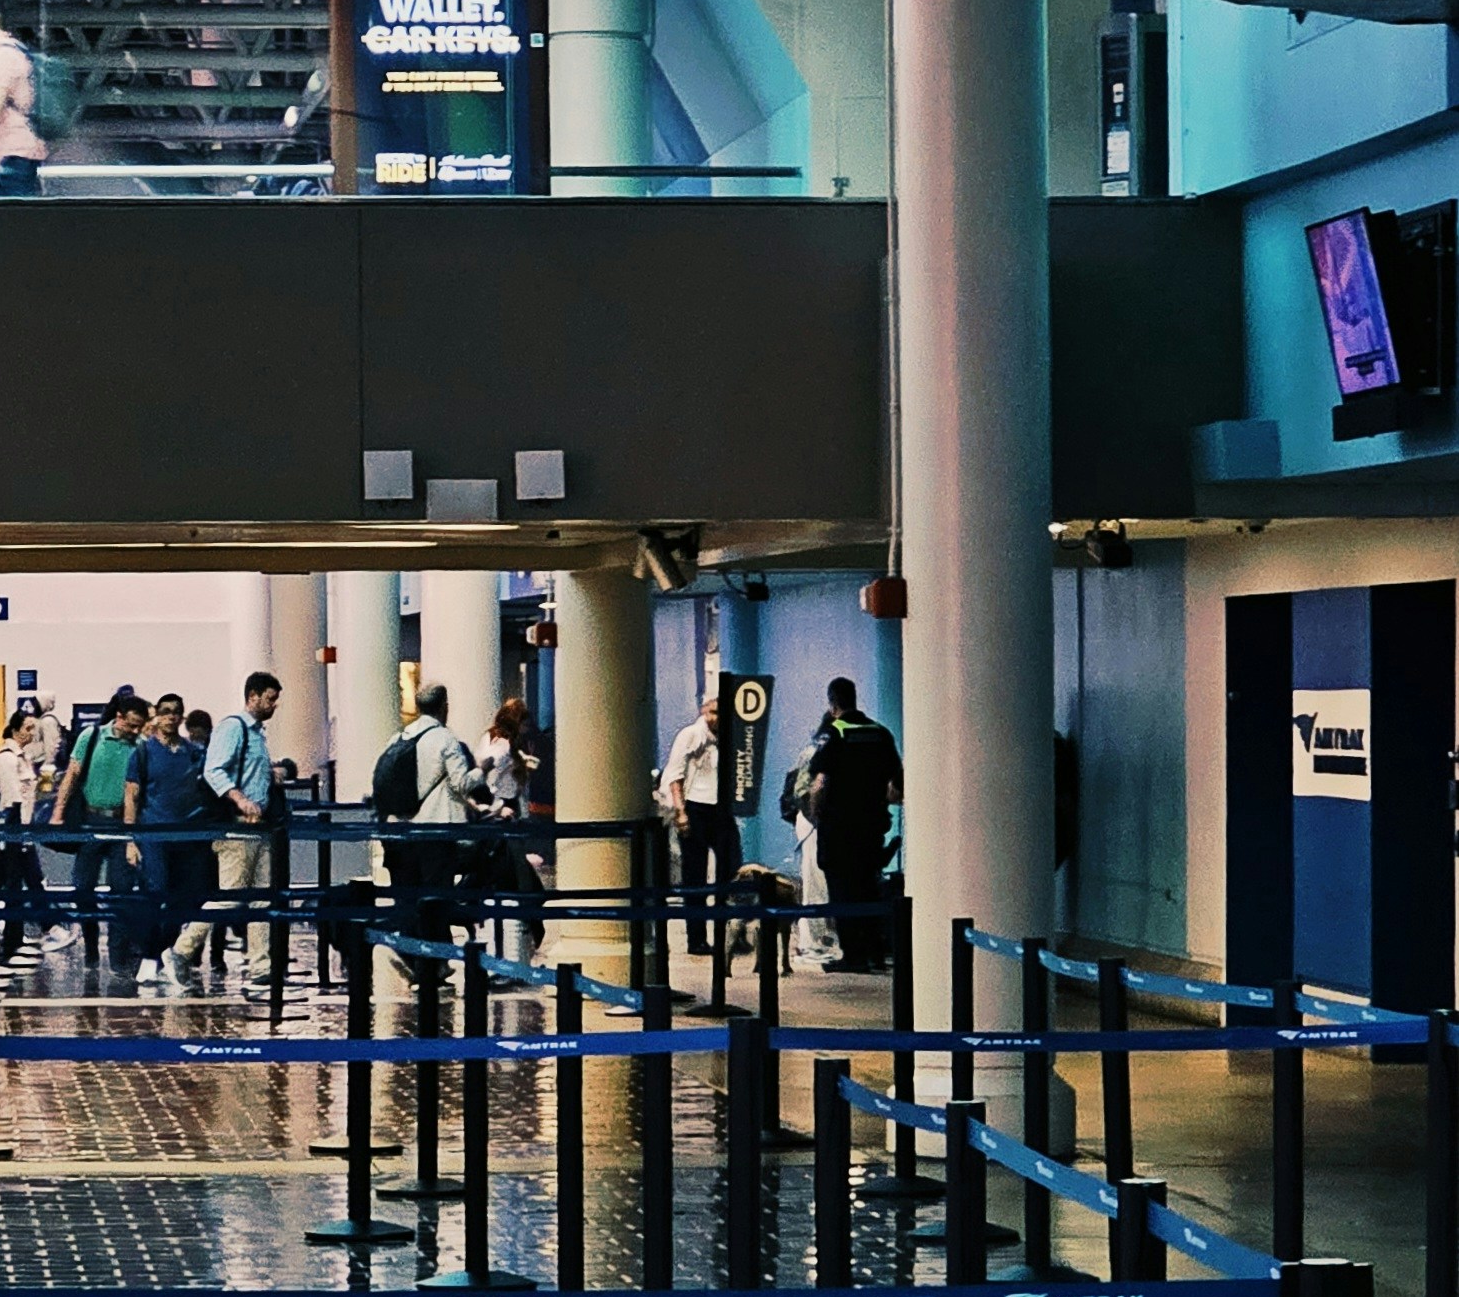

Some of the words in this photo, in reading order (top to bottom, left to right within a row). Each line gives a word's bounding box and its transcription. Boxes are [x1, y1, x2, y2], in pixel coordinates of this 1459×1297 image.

[376, 162, 427, 184] RIDE
[742, 688, 761, 714] D
[1299, 1030, 1358, 1039] AMTRAK
[521, 1041, 577, 1051] AMTRAK
[983, 1037, 1041, 1046] AMTRAK
[201, 1046, 261, 1054] AMTRAK
